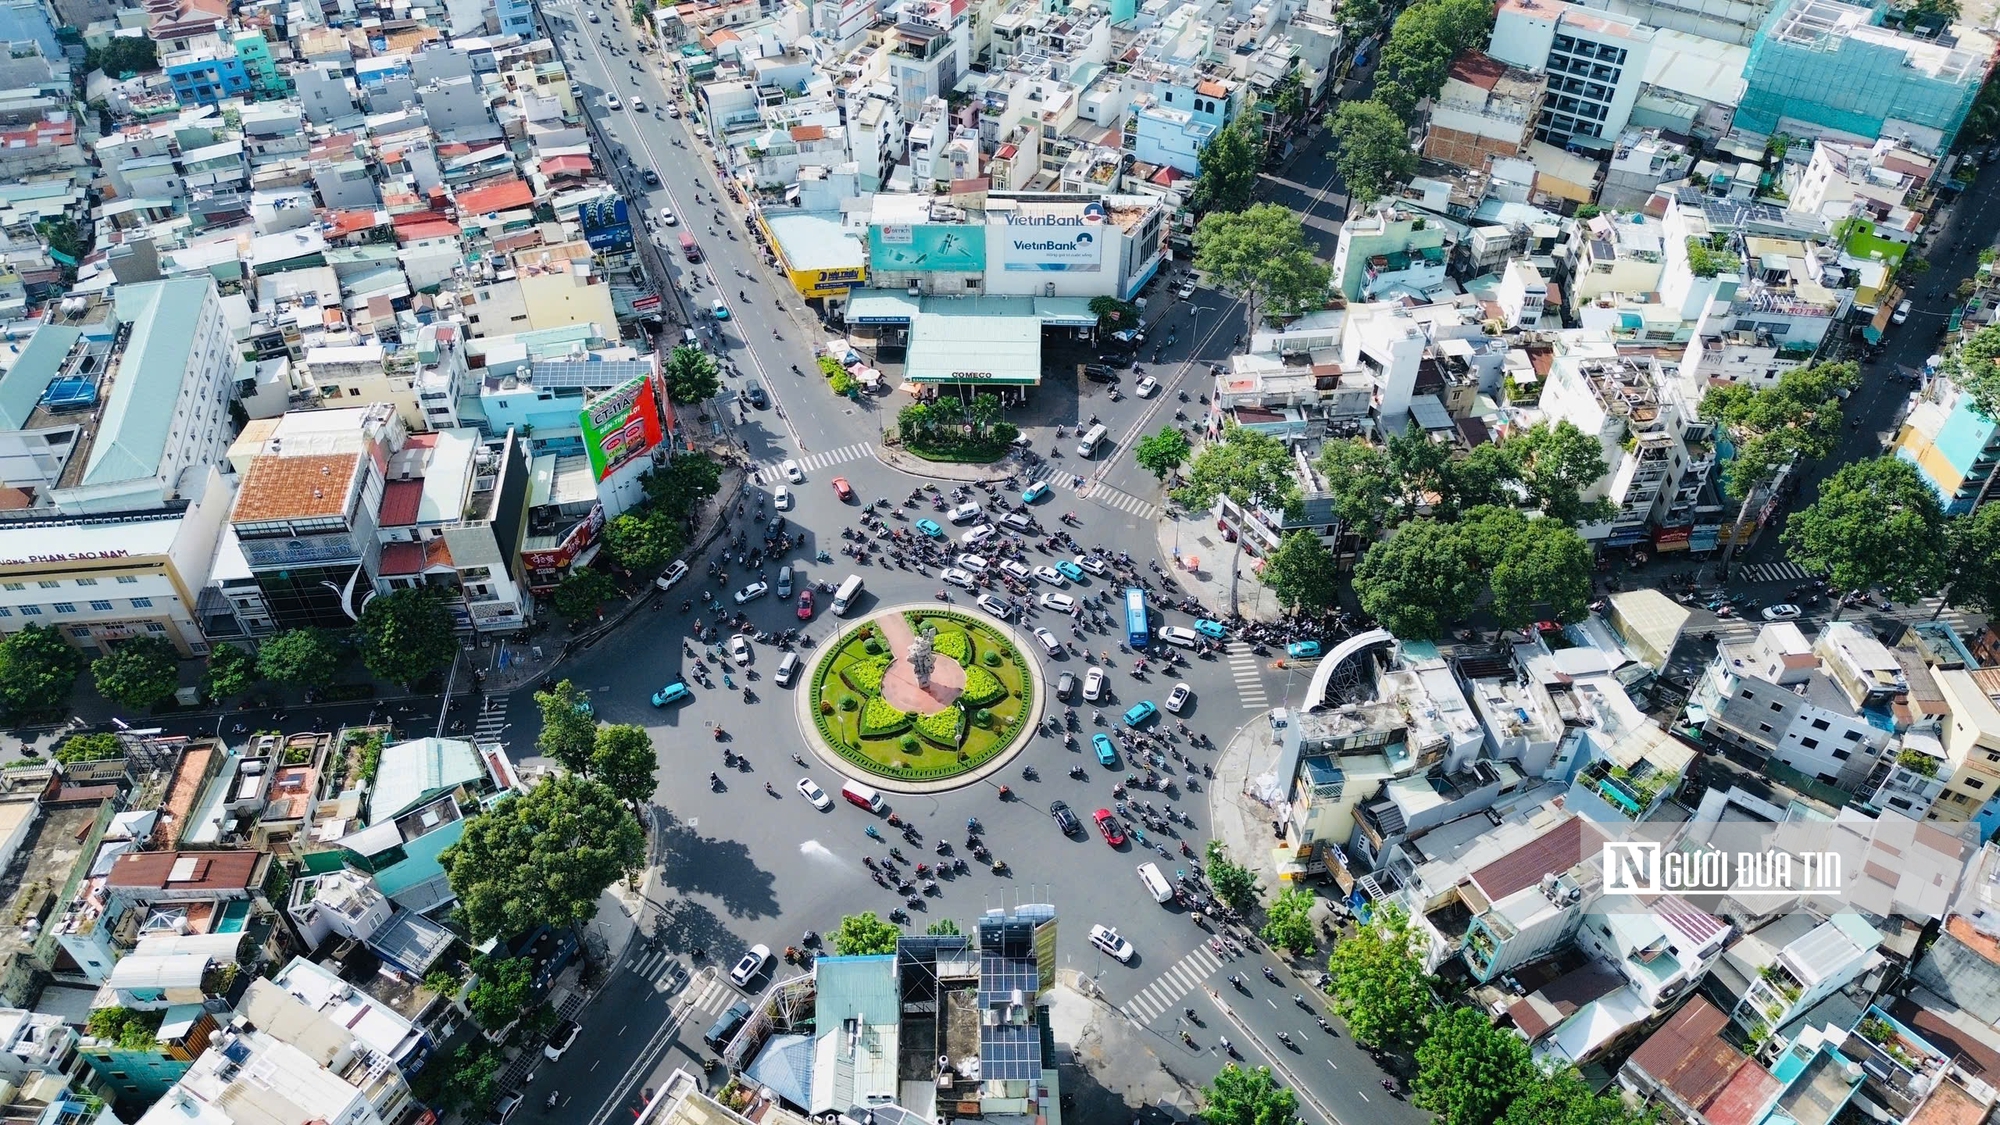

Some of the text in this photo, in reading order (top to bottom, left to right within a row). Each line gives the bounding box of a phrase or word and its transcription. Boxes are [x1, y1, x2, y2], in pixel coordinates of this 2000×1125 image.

[1005, 213, 1084, 226] VietinBank
[1014, 240, 1077, 251] VietinBank
[594, 398, 631, 425] CT-11A
[29, 553, 67, 563] PHAN
[99, 549, 130, 559] NAM
